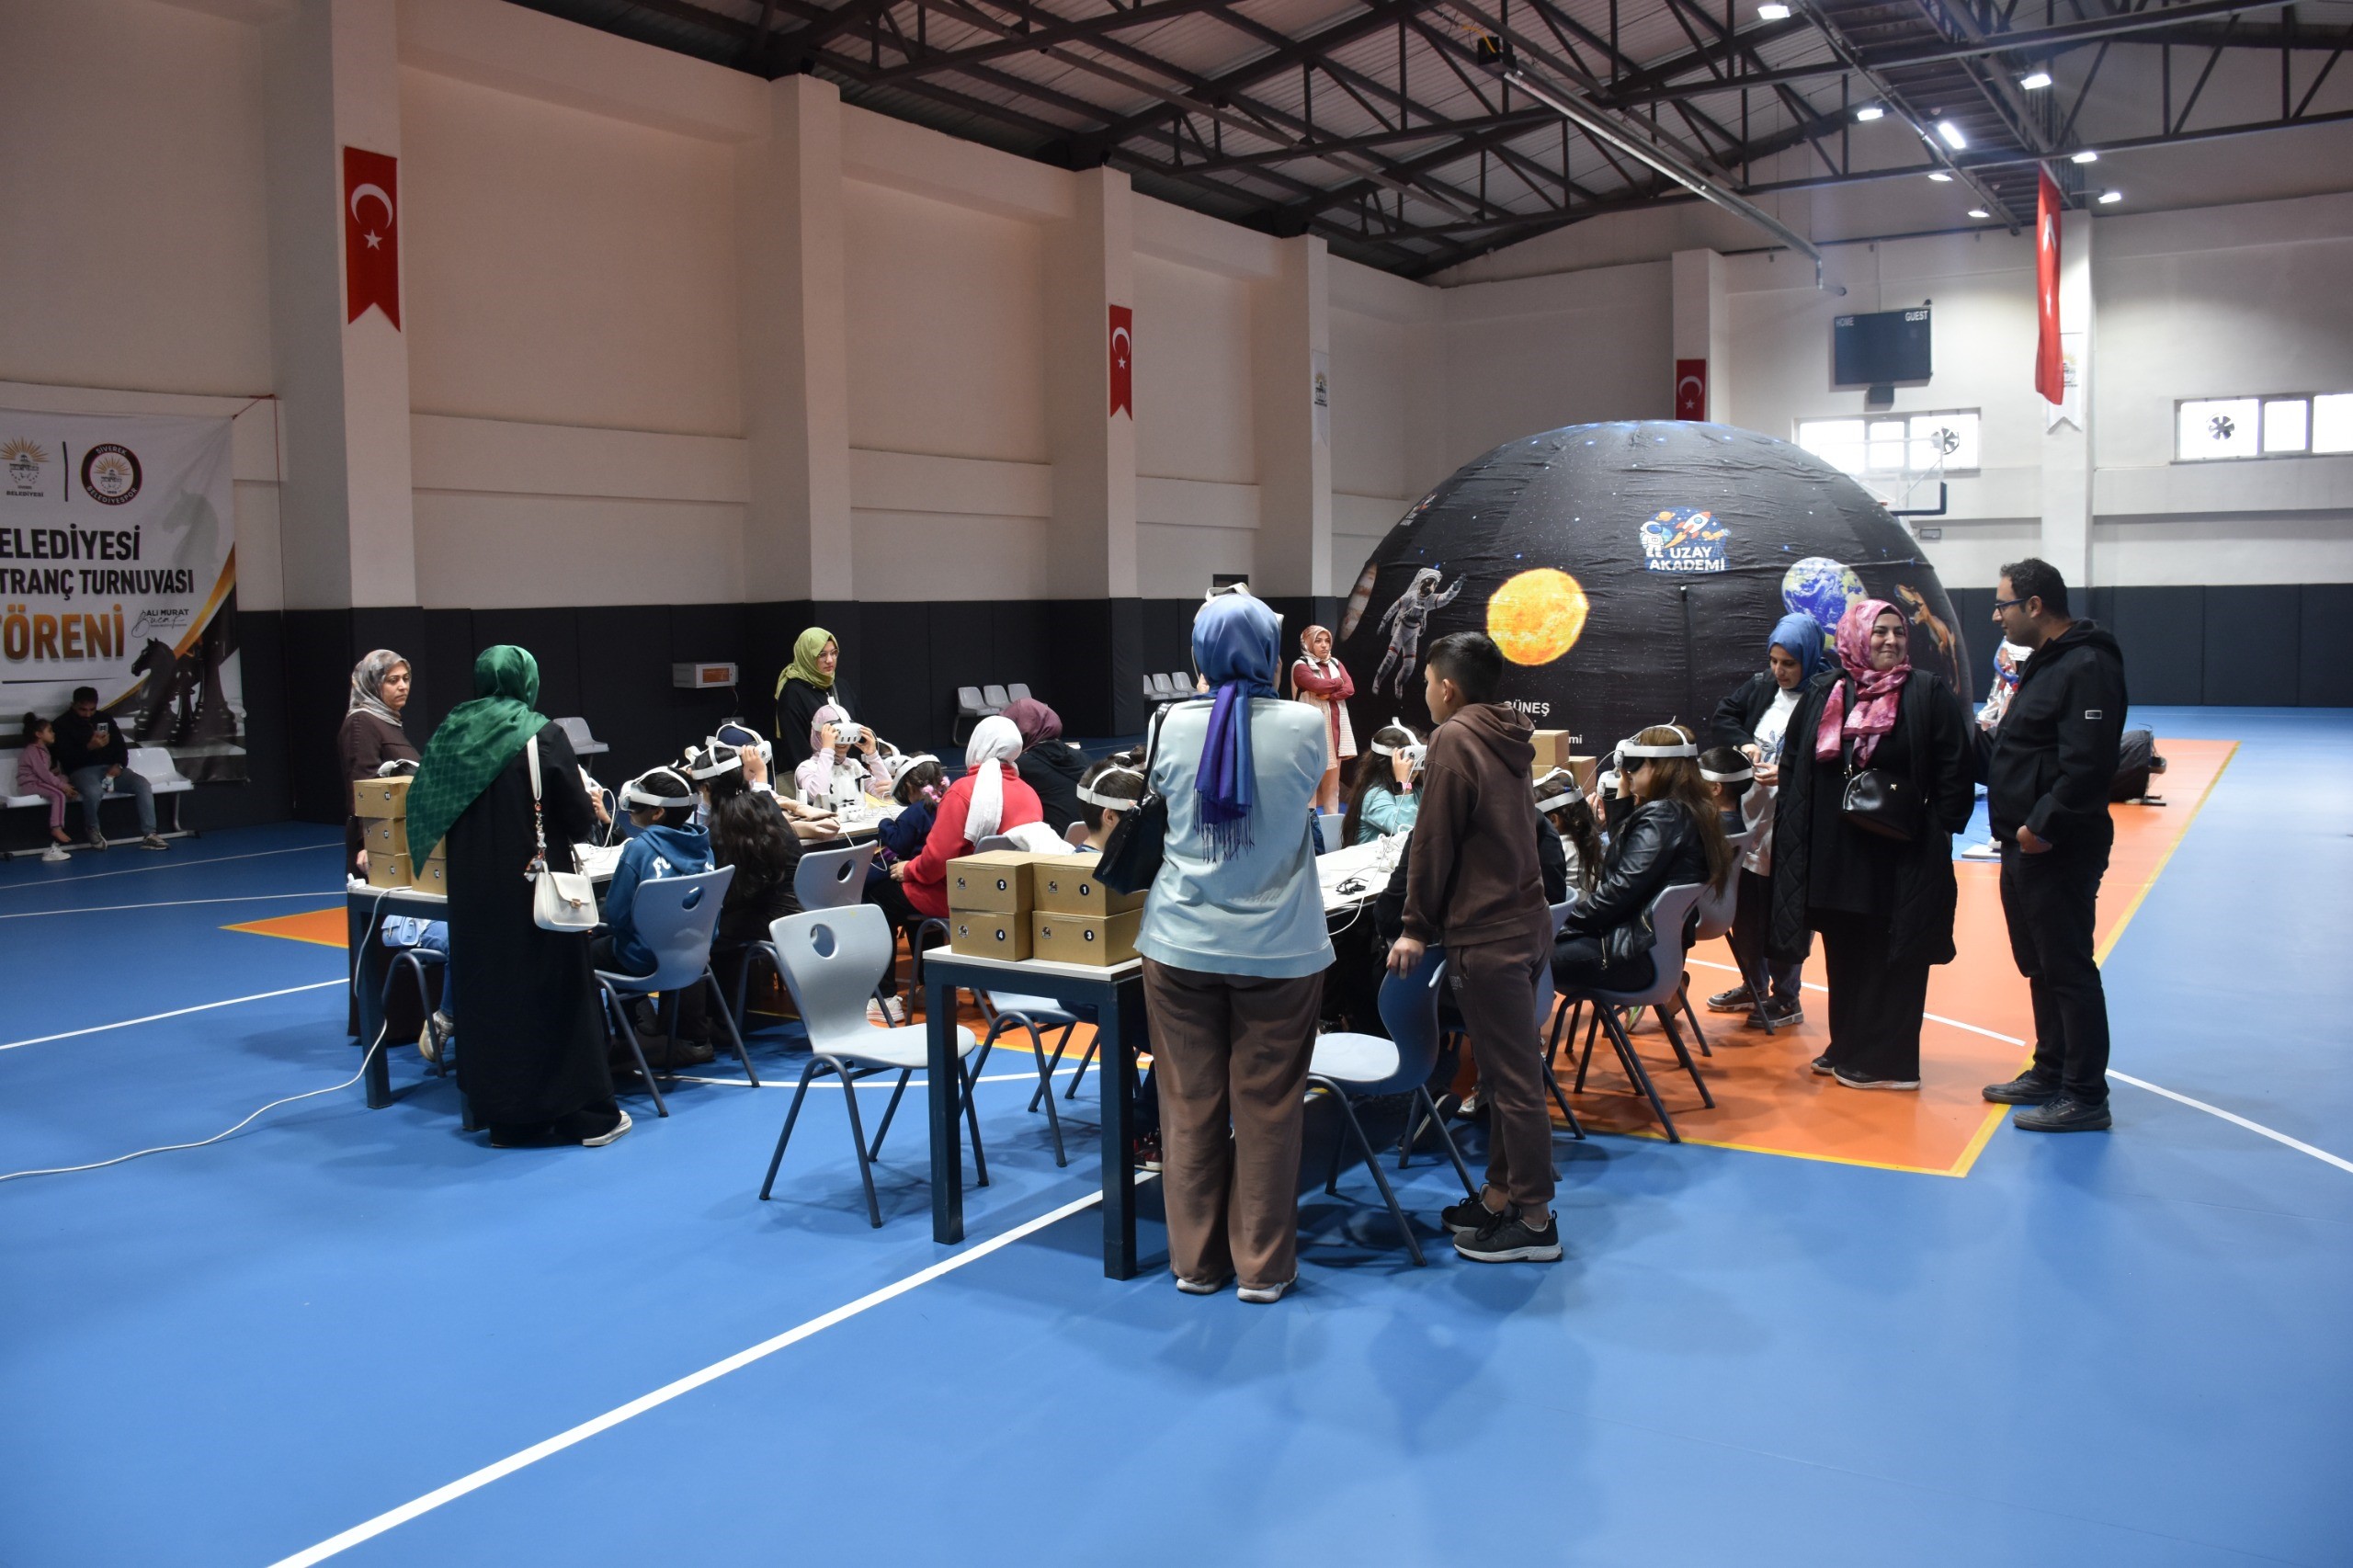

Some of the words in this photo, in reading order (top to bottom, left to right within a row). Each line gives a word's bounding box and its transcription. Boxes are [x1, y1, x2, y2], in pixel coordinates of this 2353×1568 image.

[1836, 317, 1854, 326] HOME
[1905, 311, 1928, 322] GUEST
[86, 486, 137, 504] BELEDİYESPOR
[1669, 546, 1712, 558] UZAY
[1649, 558, 1725, 571] AKADEMİ
[79, 569, 194, 595] TURNUVASI
[0, 603, 125, 661] ÖRENİ
